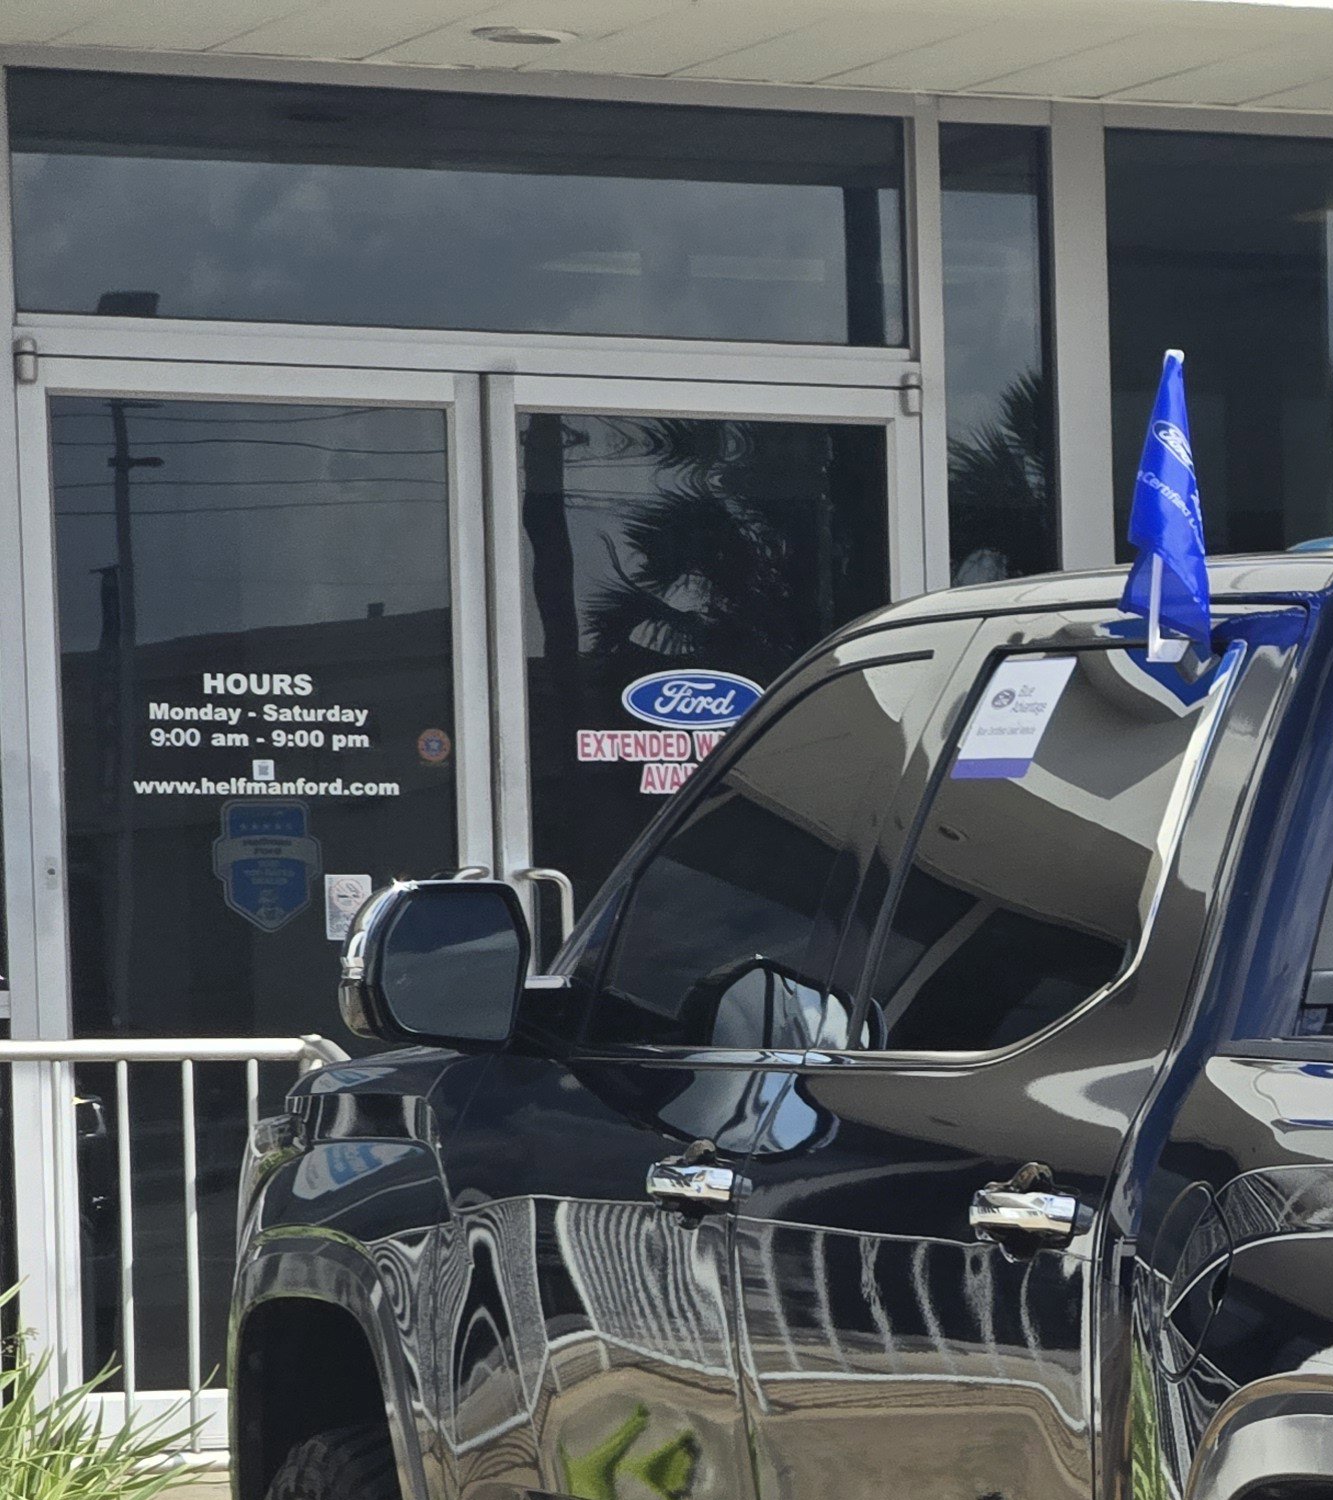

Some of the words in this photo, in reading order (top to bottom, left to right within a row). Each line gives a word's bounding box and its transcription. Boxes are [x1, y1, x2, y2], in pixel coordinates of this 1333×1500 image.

[202, 673, 313, 696] HOURS
[653, 680, 736, 715] Ford
[148, 702, 241, 725] Monday
[262, 704, 368, 727] Saturday
[150, 727, 201, 747] 9:00
[210, 731, 249, 747] am
[271, 729, 324, 747] 9:00
[332, 733, 370, 751] pm
[578, 731, 690, 760] EXTENDED
[133, 777, 400, 796] www.helfmanford.com
